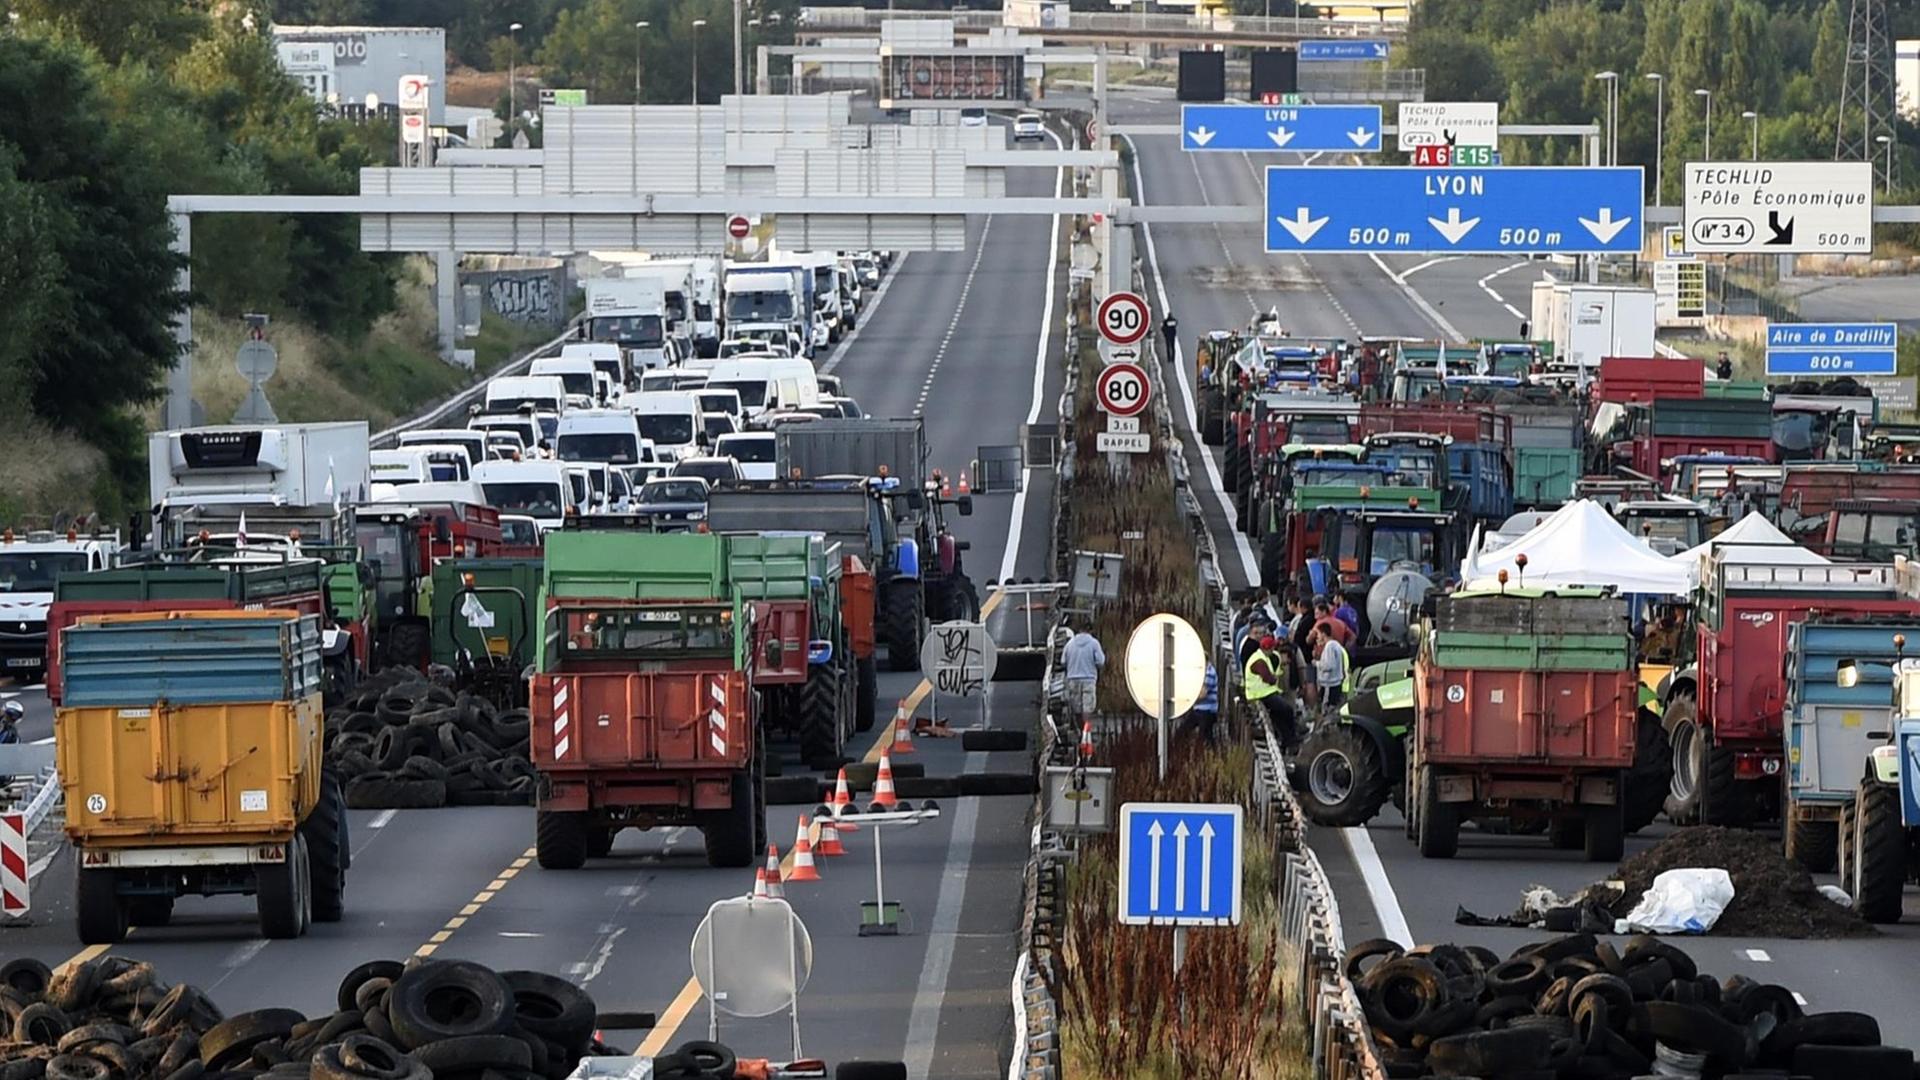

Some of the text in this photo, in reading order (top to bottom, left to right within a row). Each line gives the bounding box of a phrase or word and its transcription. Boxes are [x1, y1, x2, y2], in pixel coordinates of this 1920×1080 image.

[1265, 110, 1298, 121] LYON
[1404, 106, 1446, 115] TECHLID
[1695, 169, 1773, 185] TECHLID
[1425, 175, 1484, 196] LYON
[1753, 186, 1866, 208] Économique
[1349, 228, 1411, 245] 500 m
[1499, 228, 1561, 245] 500 m
[1721, 223, 1746, 239] 34
[1818, 233, 1866, 246] 500 m
[1108, 308, 1140, 330] 90
[1772, 329, 1892, 345] Aire de Dardilly
[1810, 356, 1854, 369] 800 m
[1108, 380, 1140, 401] 80
[1103, 438, 1143, 447] RAPPEL
[91, 797, 103, 811] 25
